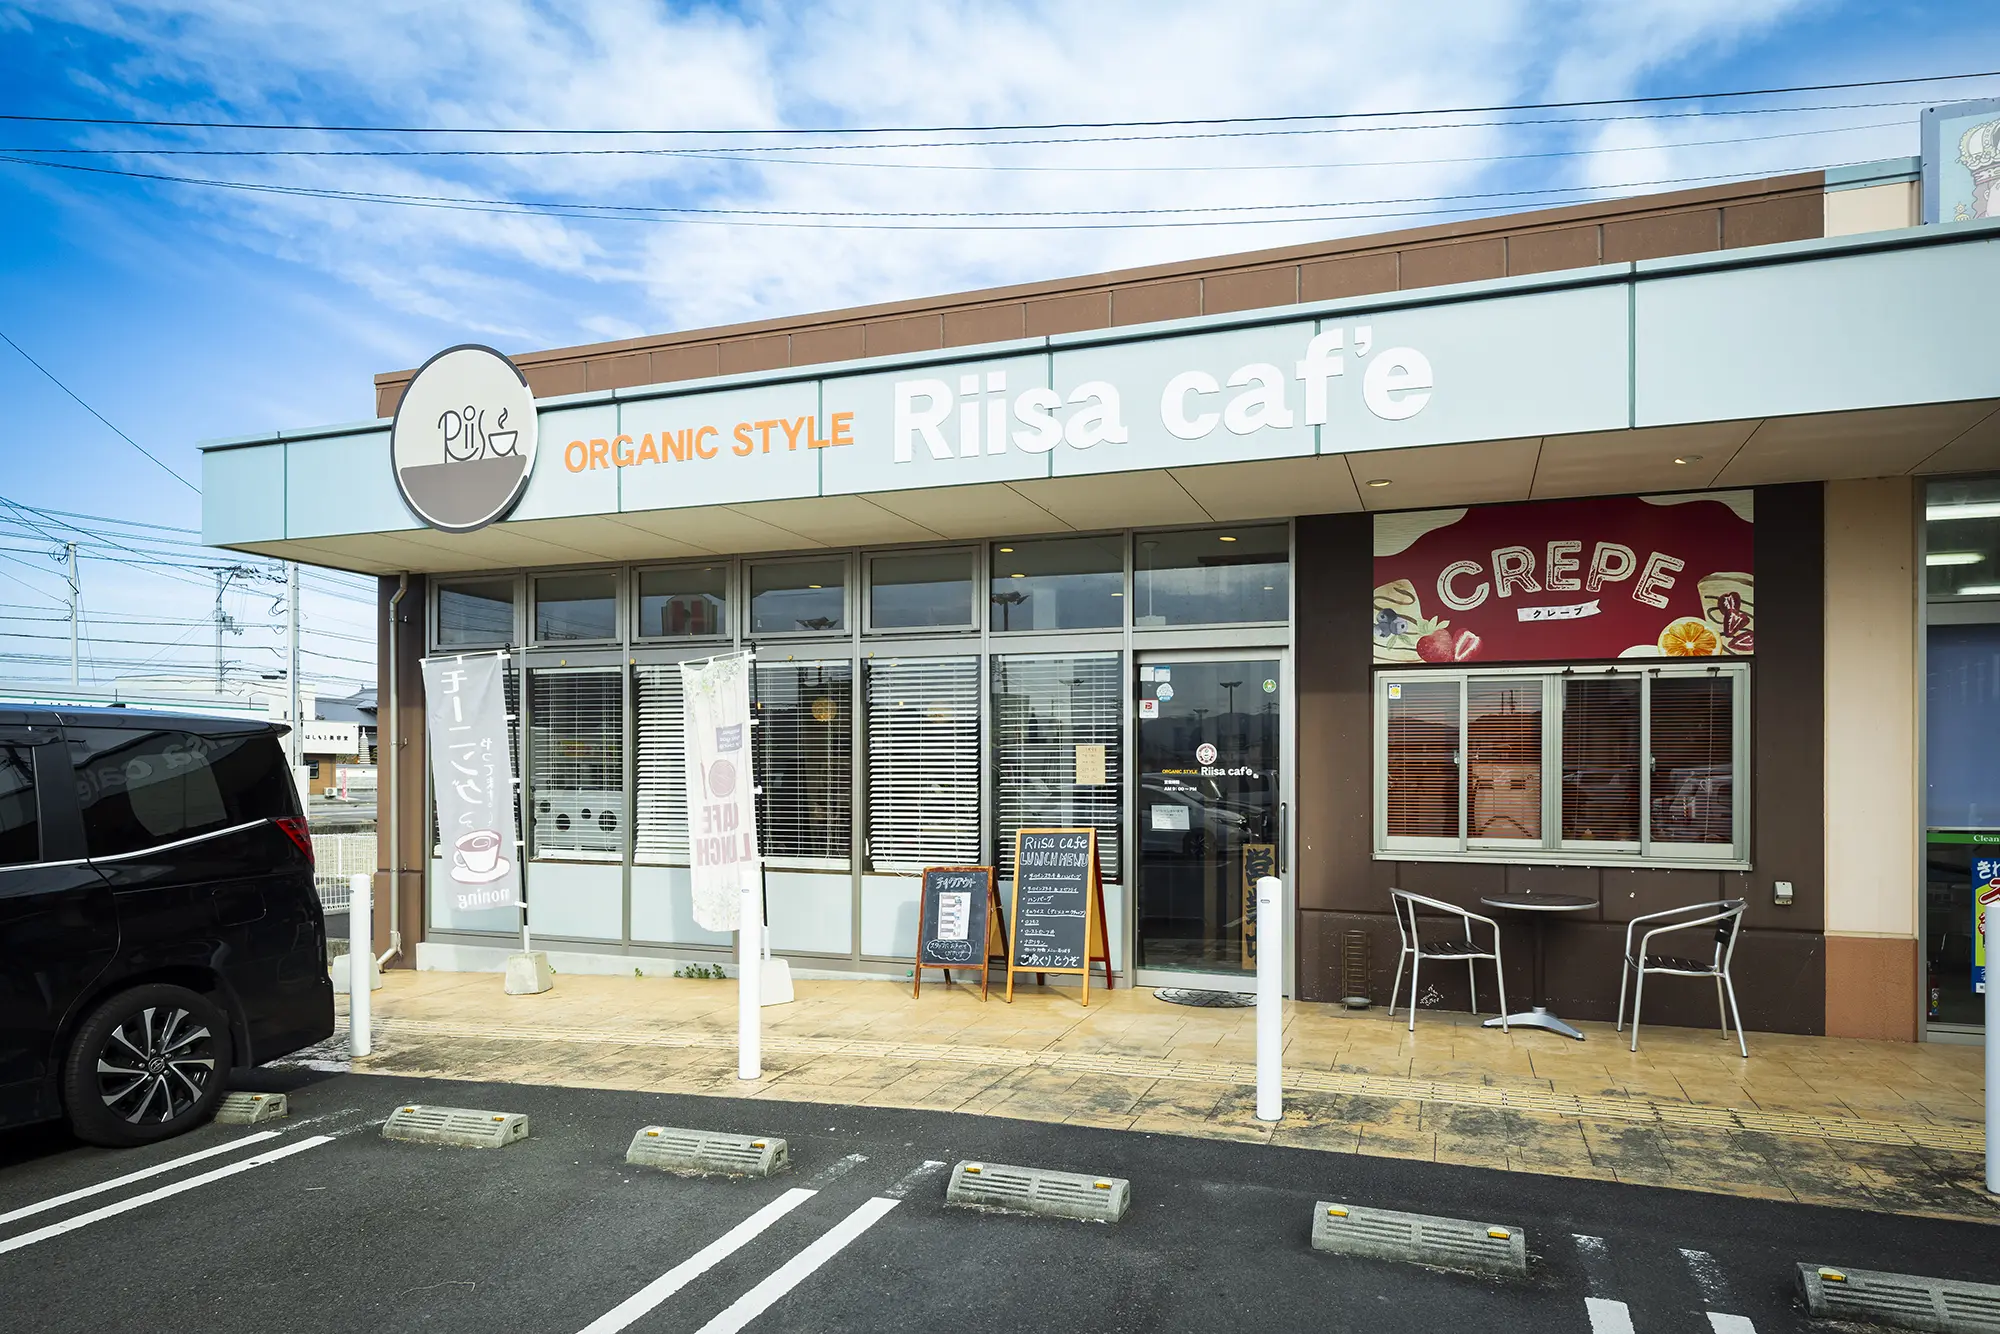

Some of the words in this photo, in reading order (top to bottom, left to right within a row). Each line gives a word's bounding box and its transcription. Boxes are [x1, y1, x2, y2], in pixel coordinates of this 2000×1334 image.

[893, 370, 1128, 464] Riisa
[564, 425, 720, 473] ORGANIC
[731, 411, 855, 456] STYLE
[1436, 540, 1686, 611] CREPE
[1532, 606, 1584, 619] クレープ
[1201, 766, 1225, 776] Riisa
[1024, 836, 1055, 850] Riisa
[1059, 835, 1088, 850] cafe
[1973, 834, 2000, 842] Clean
[1020, 851, 1058, 867] LUNCH
[1058, 852, 1089, 868] MENU
